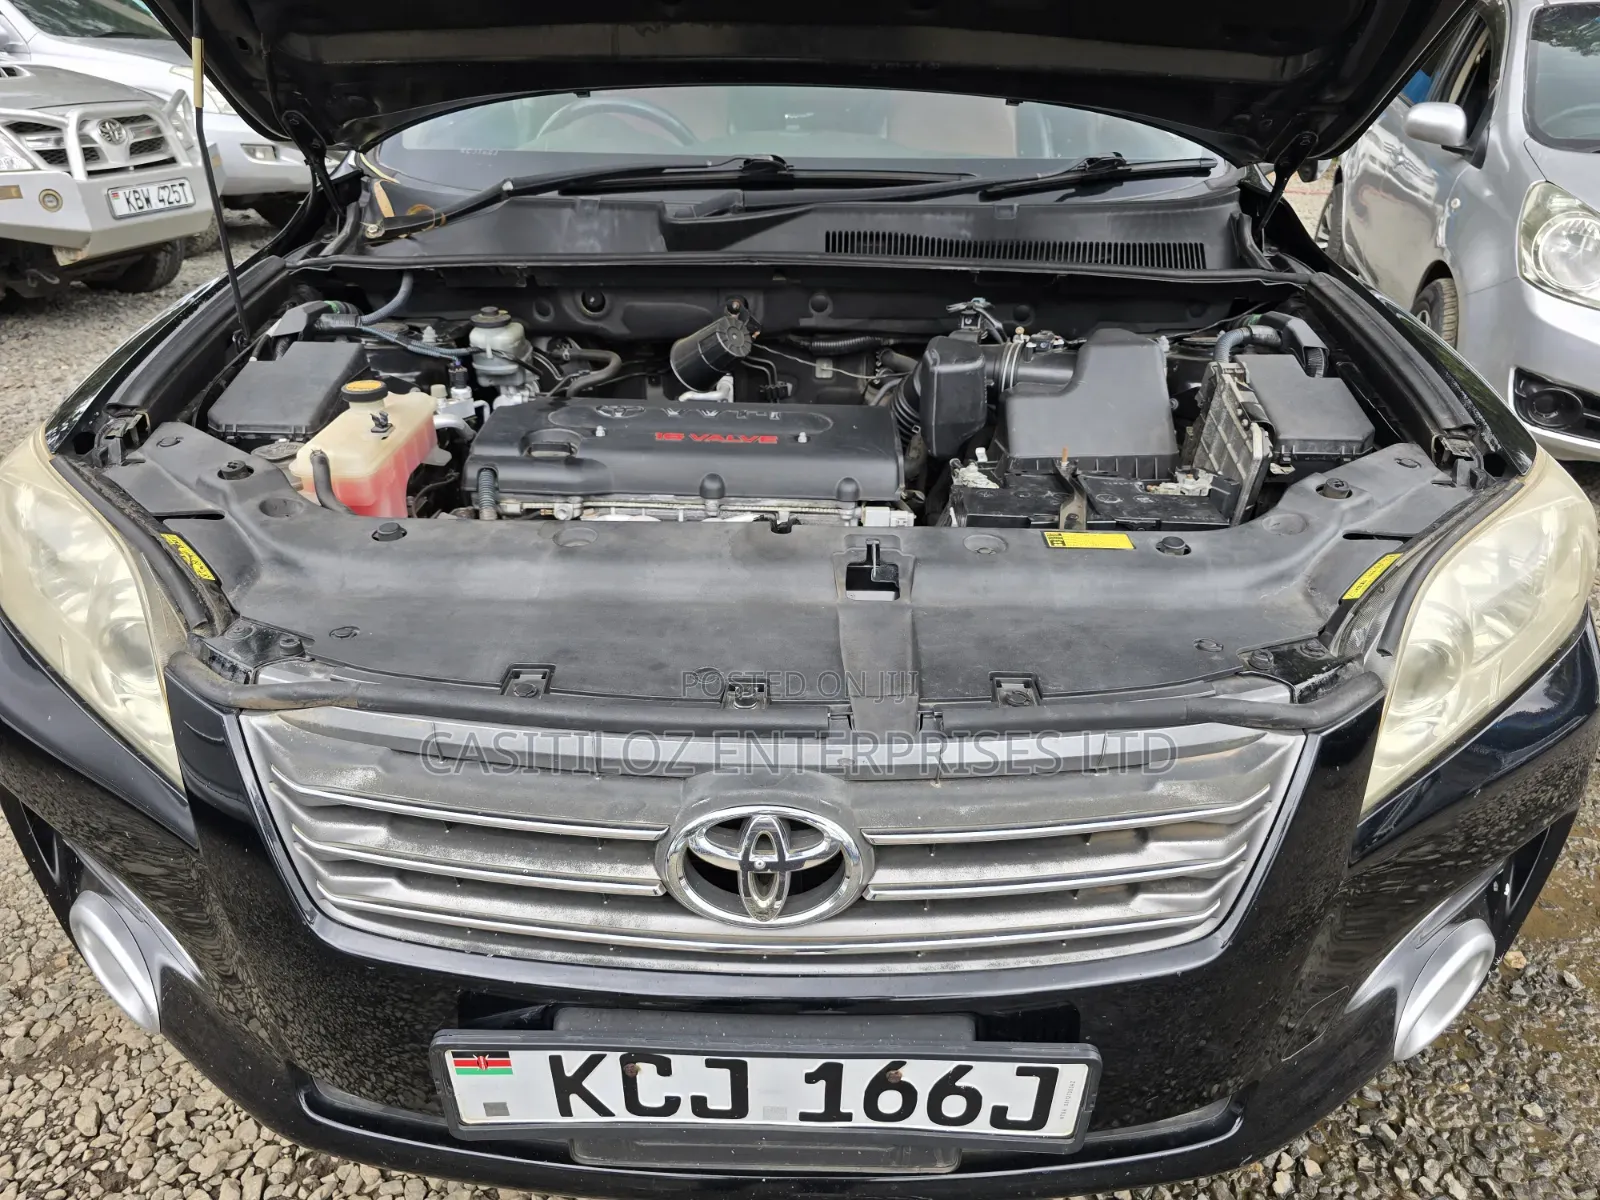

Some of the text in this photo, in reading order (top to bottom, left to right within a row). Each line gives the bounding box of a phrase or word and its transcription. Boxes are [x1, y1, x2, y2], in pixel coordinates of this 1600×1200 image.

[123, 183, 188, 212] KBW 425T
[655, 431, 778, 444] 16 VALVE
[547, 1052, 1059, 1131] KCJ 166J
